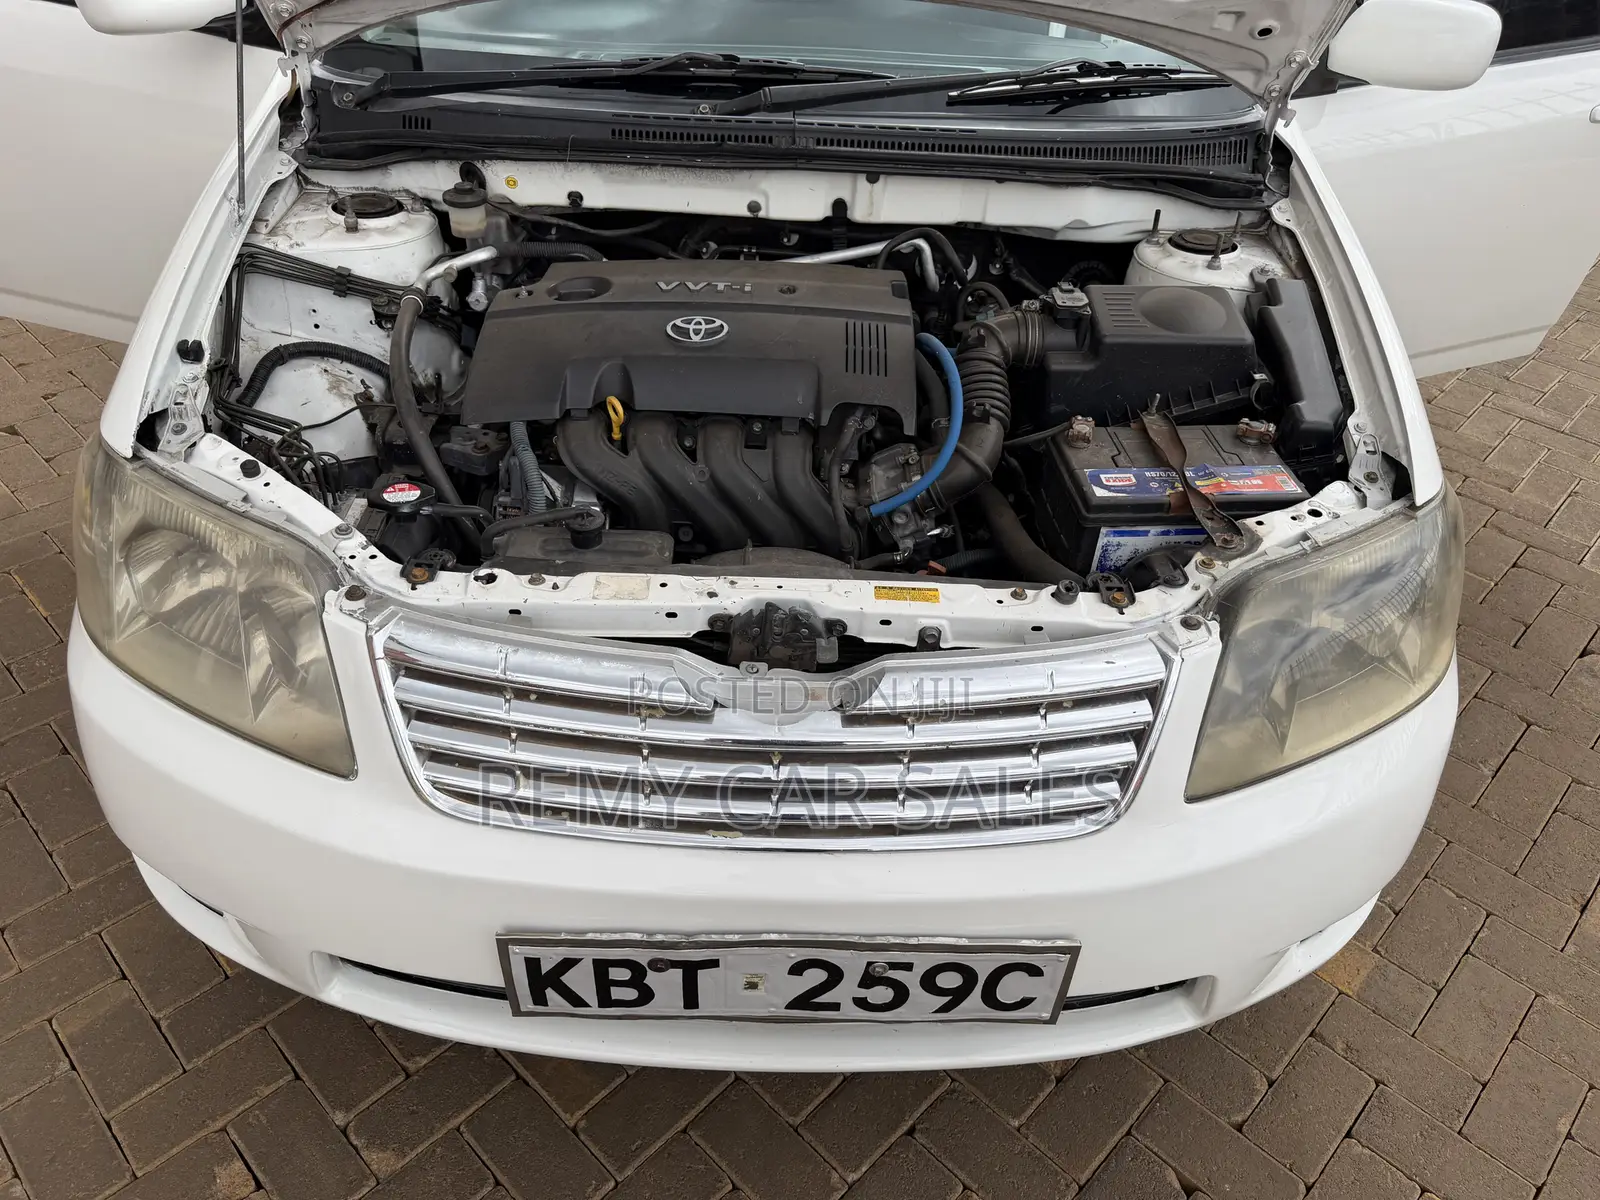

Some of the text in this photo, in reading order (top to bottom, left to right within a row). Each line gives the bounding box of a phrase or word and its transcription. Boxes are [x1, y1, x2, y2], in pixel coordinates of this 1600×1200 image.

[656, 281, 753, 292] VVT-i
[524, 956, 1046, 1014] KBT 259C
